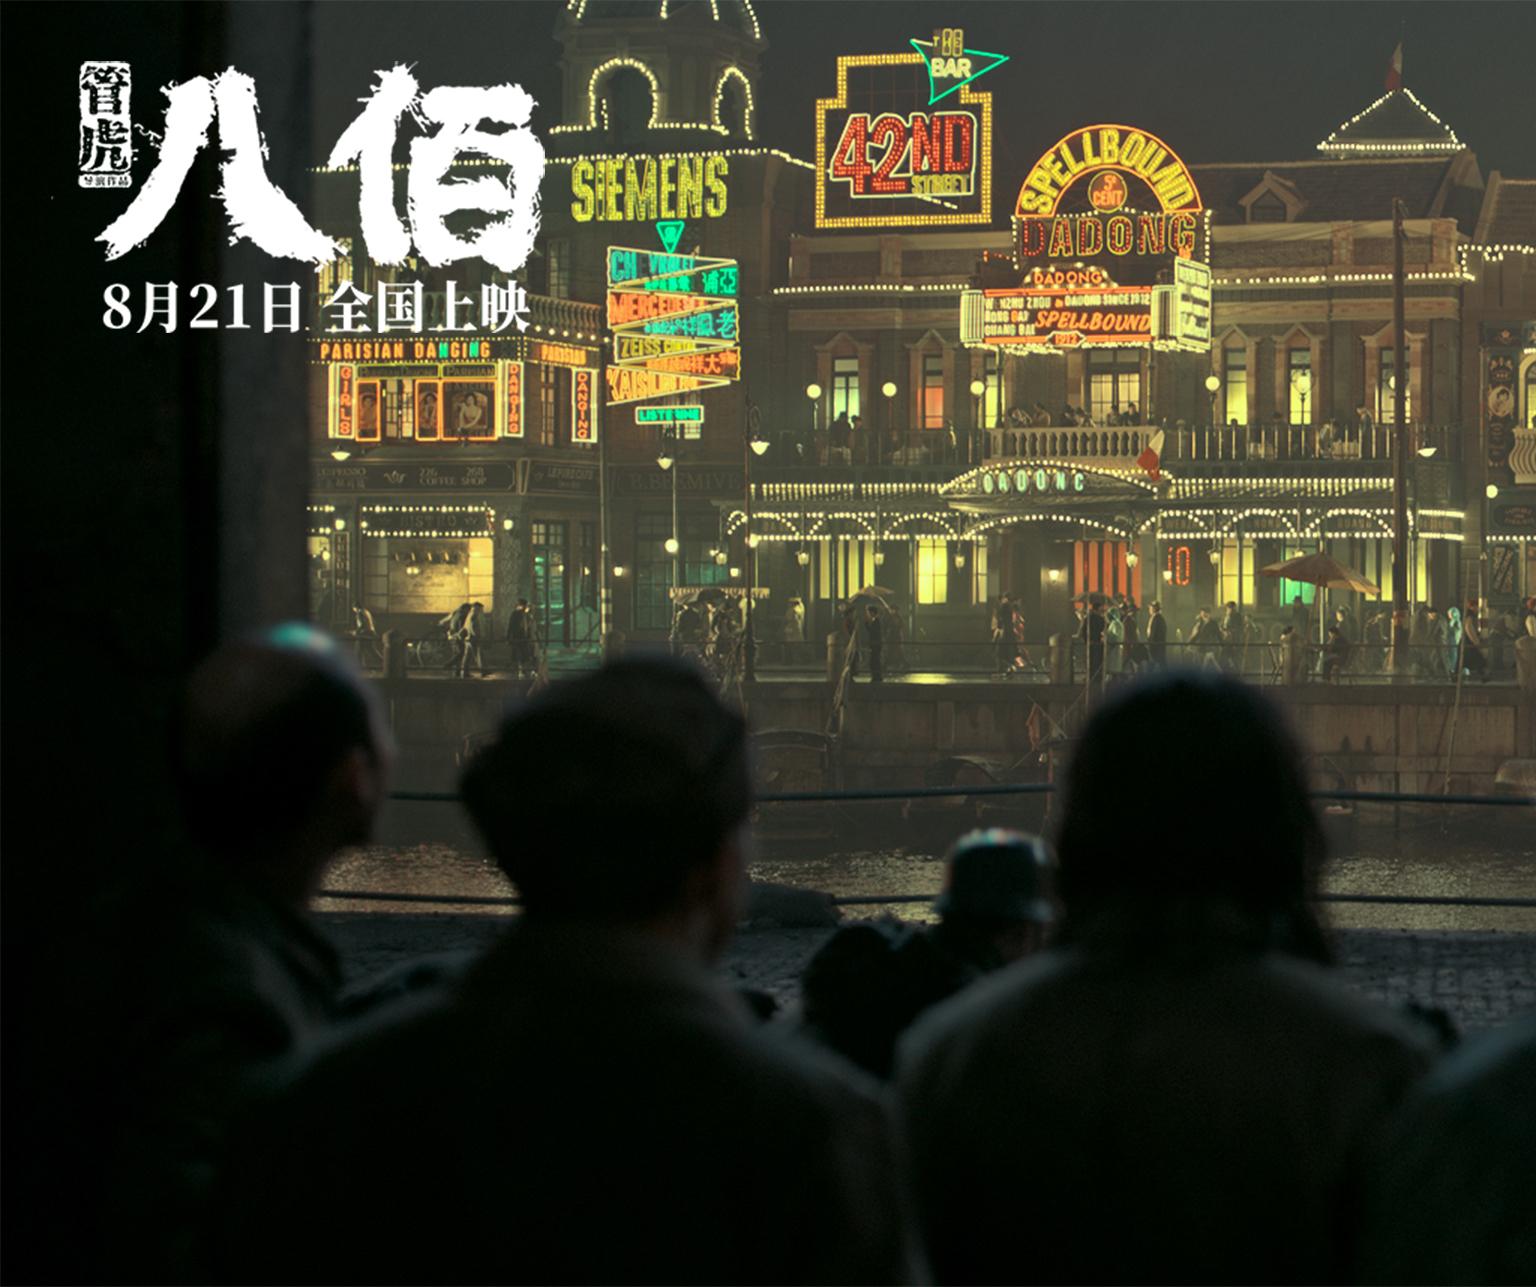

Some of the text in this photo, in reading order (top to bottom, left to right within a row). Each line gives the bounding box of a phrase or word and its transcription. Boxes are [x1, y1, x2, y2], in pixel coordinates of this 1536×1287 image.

[931, 57, 972, 78] BAR
[833, 115, 972, 194] 42ND
[1020, 127, 1196, 214] SPELLBOUND
[571, 155, 729, 222] SIEMENS
[911, 174, 971, 194] STREET
[1092, 190, 1123, 207] CENT
[1022, 214, 1197, 258] DADONG
[1034, 271, 1104, 284] DADONG
[1035, 310, 1152, 332] SPELLBOUND
[320, 343, 404, 360] PARISIAN
[540, 343, 587, 365] PARISIAN
[339, 366, 352, 435] GIRLS
[461, 475, 488, 486] SHOP
